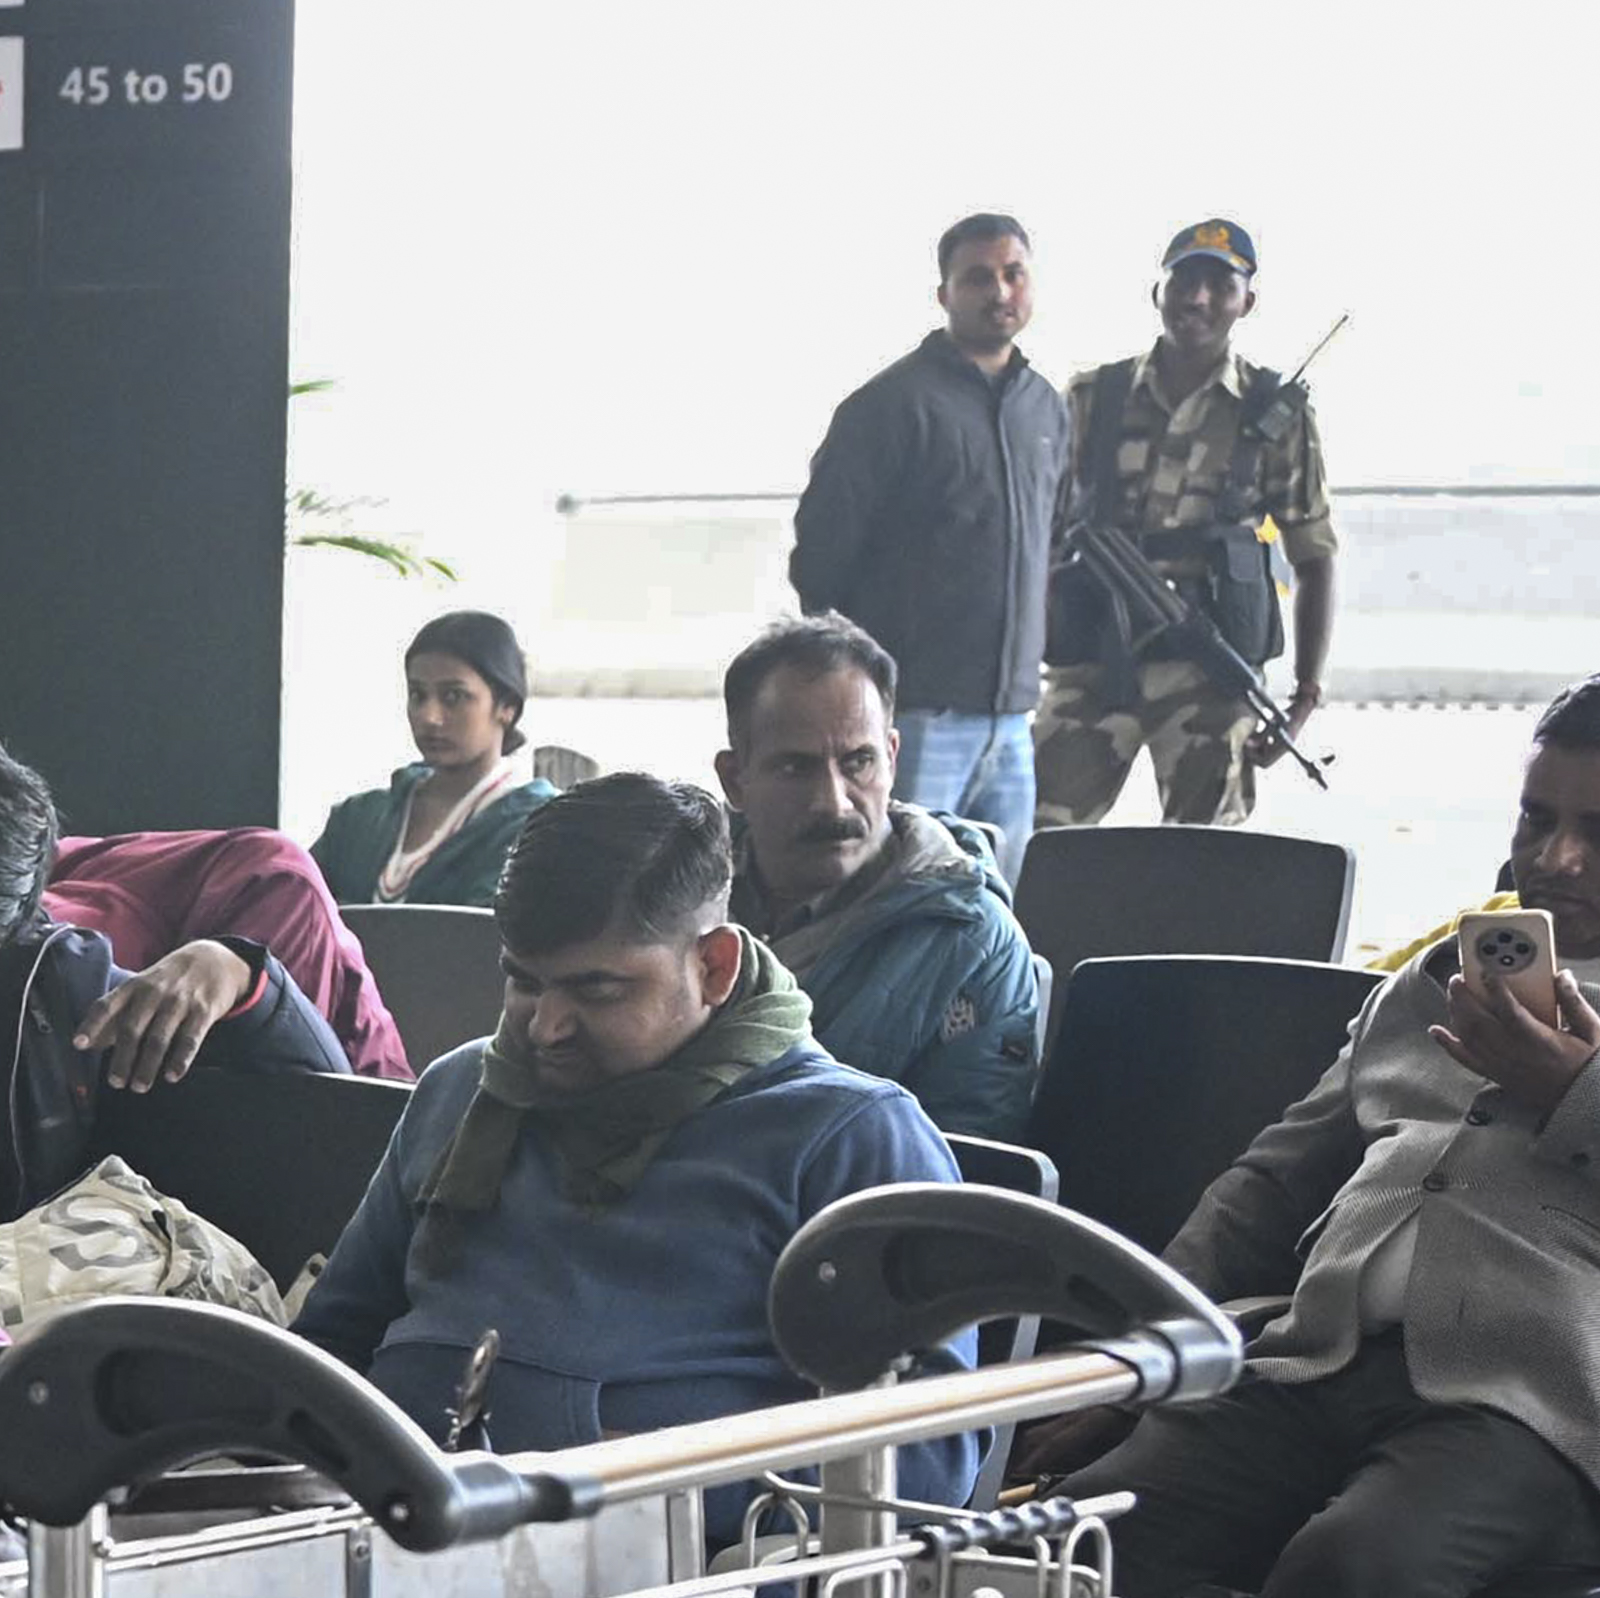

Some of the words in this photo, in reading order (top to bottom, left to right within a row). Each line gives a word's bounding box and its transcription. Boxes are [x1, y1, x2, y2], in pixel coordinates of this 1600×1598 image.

[60, 65, 110, 105] 45
[124, 69, 169, 102] to
[182, 62, 233, 102] 50
